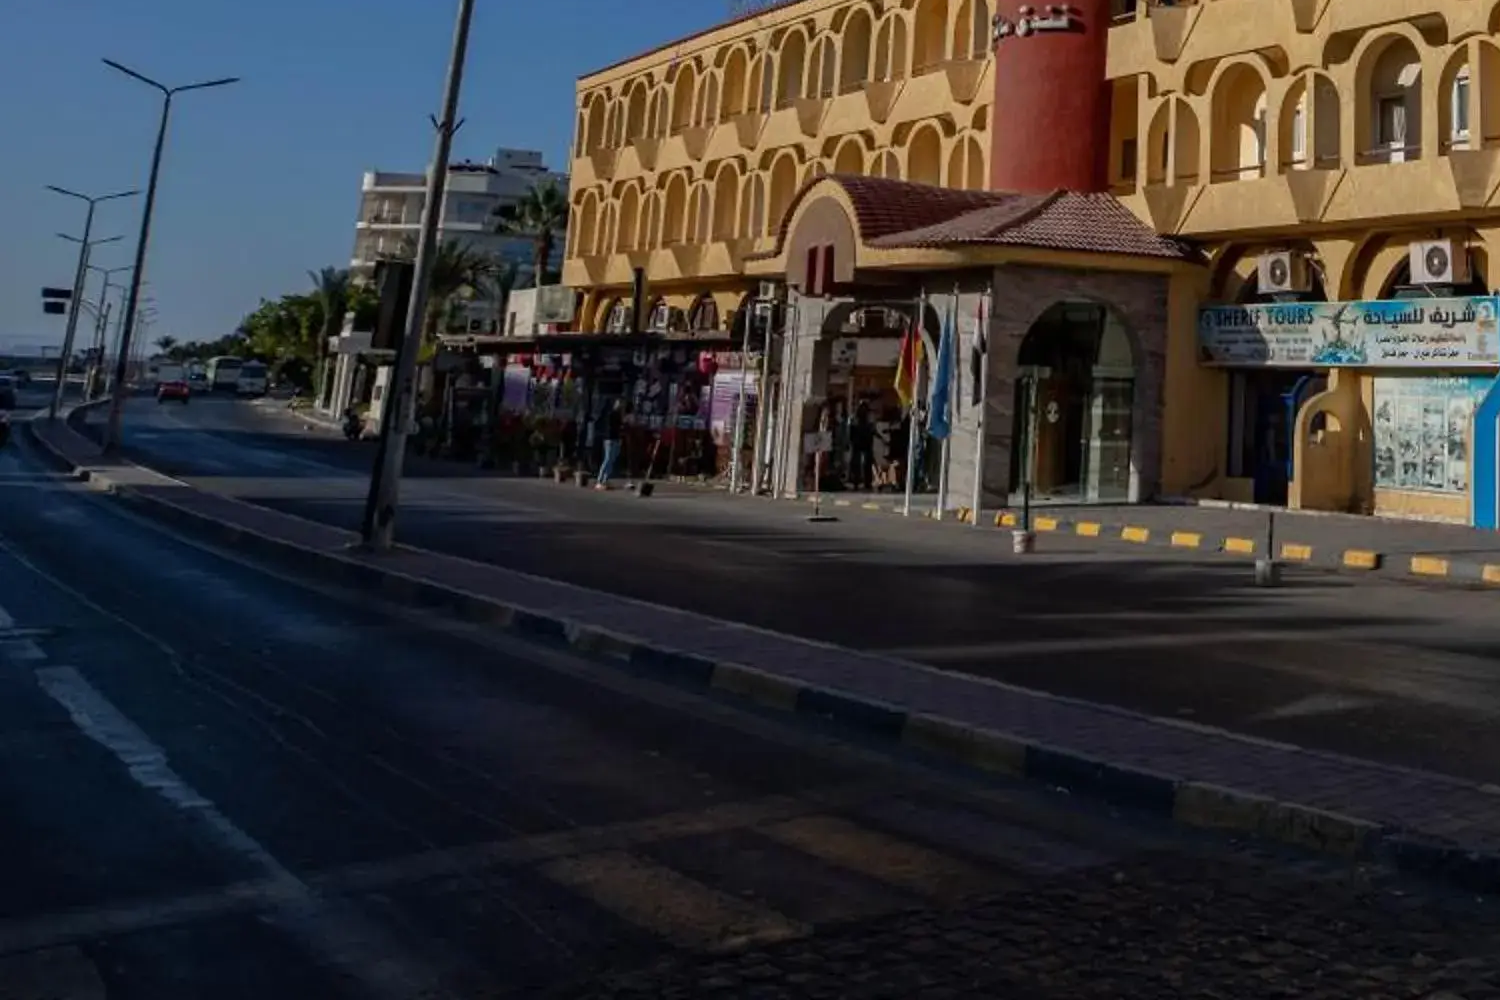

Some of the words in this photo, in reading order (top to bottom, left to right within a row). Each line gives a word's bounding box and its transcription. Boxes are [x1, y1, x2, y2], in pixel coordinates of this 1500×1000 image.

[1215, 306, 1260, 327] SHERIF
[1265, 305, 1314, 325] TOURS
[1363, 306, 1425, 329] للسياحة
[1429, 303, 1476, 328] شريف
